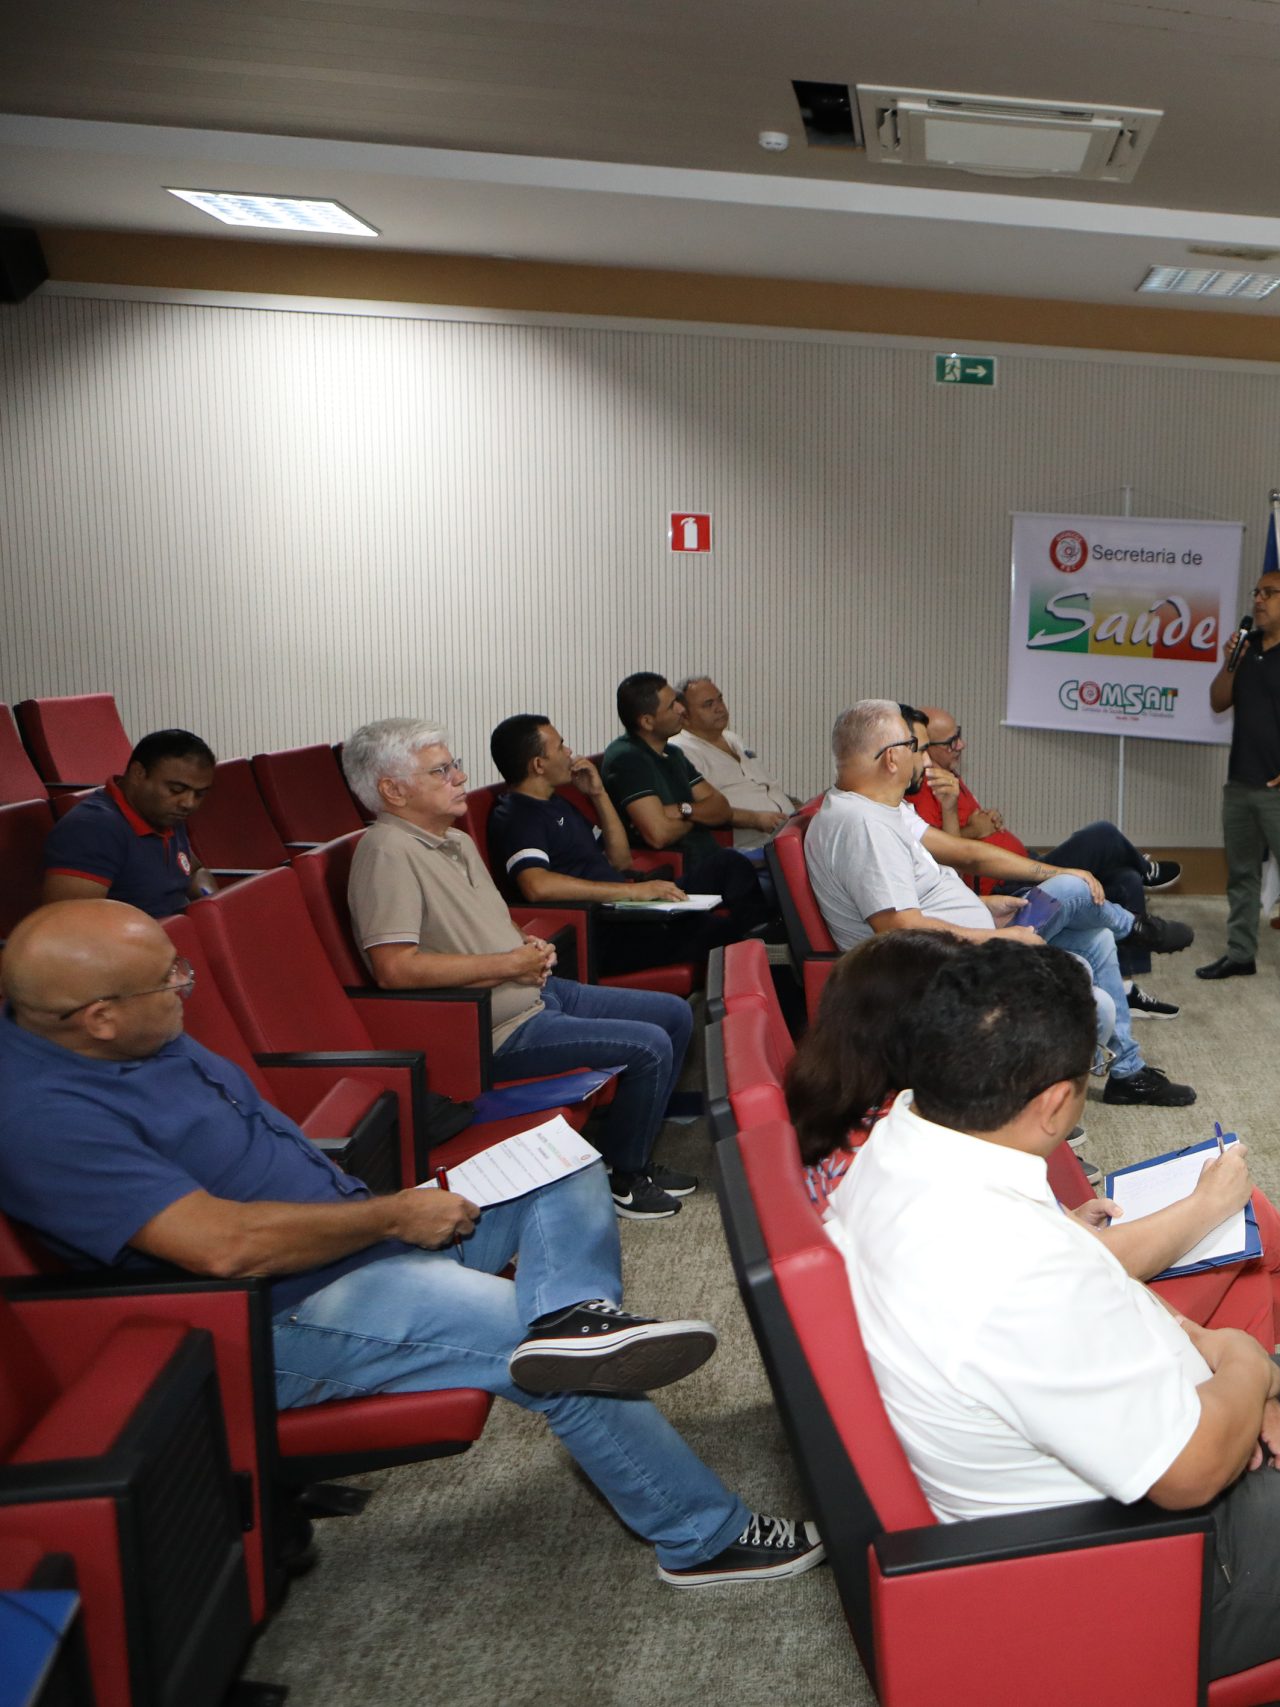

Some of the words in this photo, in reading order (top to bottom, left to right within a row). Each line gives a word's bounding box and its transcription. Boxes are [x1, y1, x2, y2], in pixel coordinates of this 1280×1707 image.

[1092, 544, 1177, 565] Secretaria
[1181, 550, 1203, 566] de
[1058, 679, 1179, 715] COMSAT
